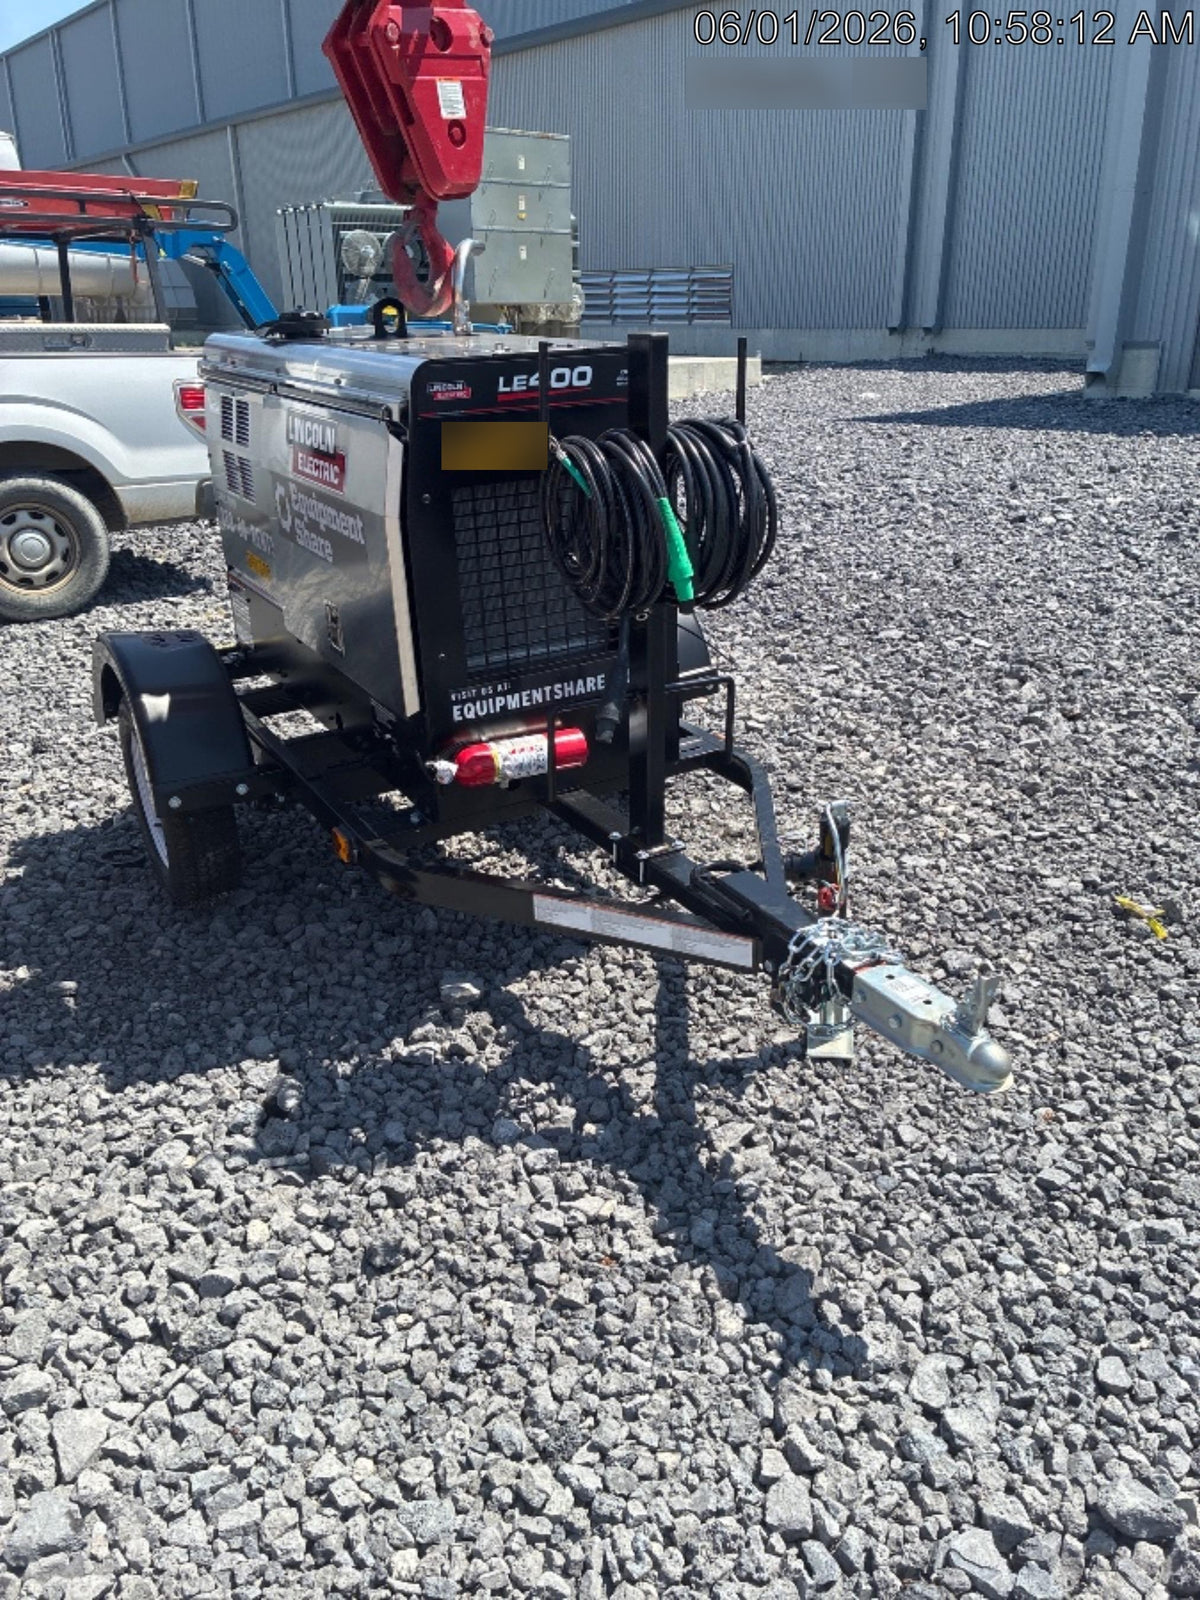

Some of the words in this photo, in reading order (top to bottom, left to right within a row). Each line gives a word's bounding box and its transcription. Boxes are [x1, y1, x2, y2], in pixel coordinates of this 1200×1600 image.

[289, 415, 336, 454] LINCOLN
[298, 452, 340, 485] ELECTRIC
[289, 482, 365, 545] Equipment
[452, 674, 606, 722] EQUIPMENTSHARE
